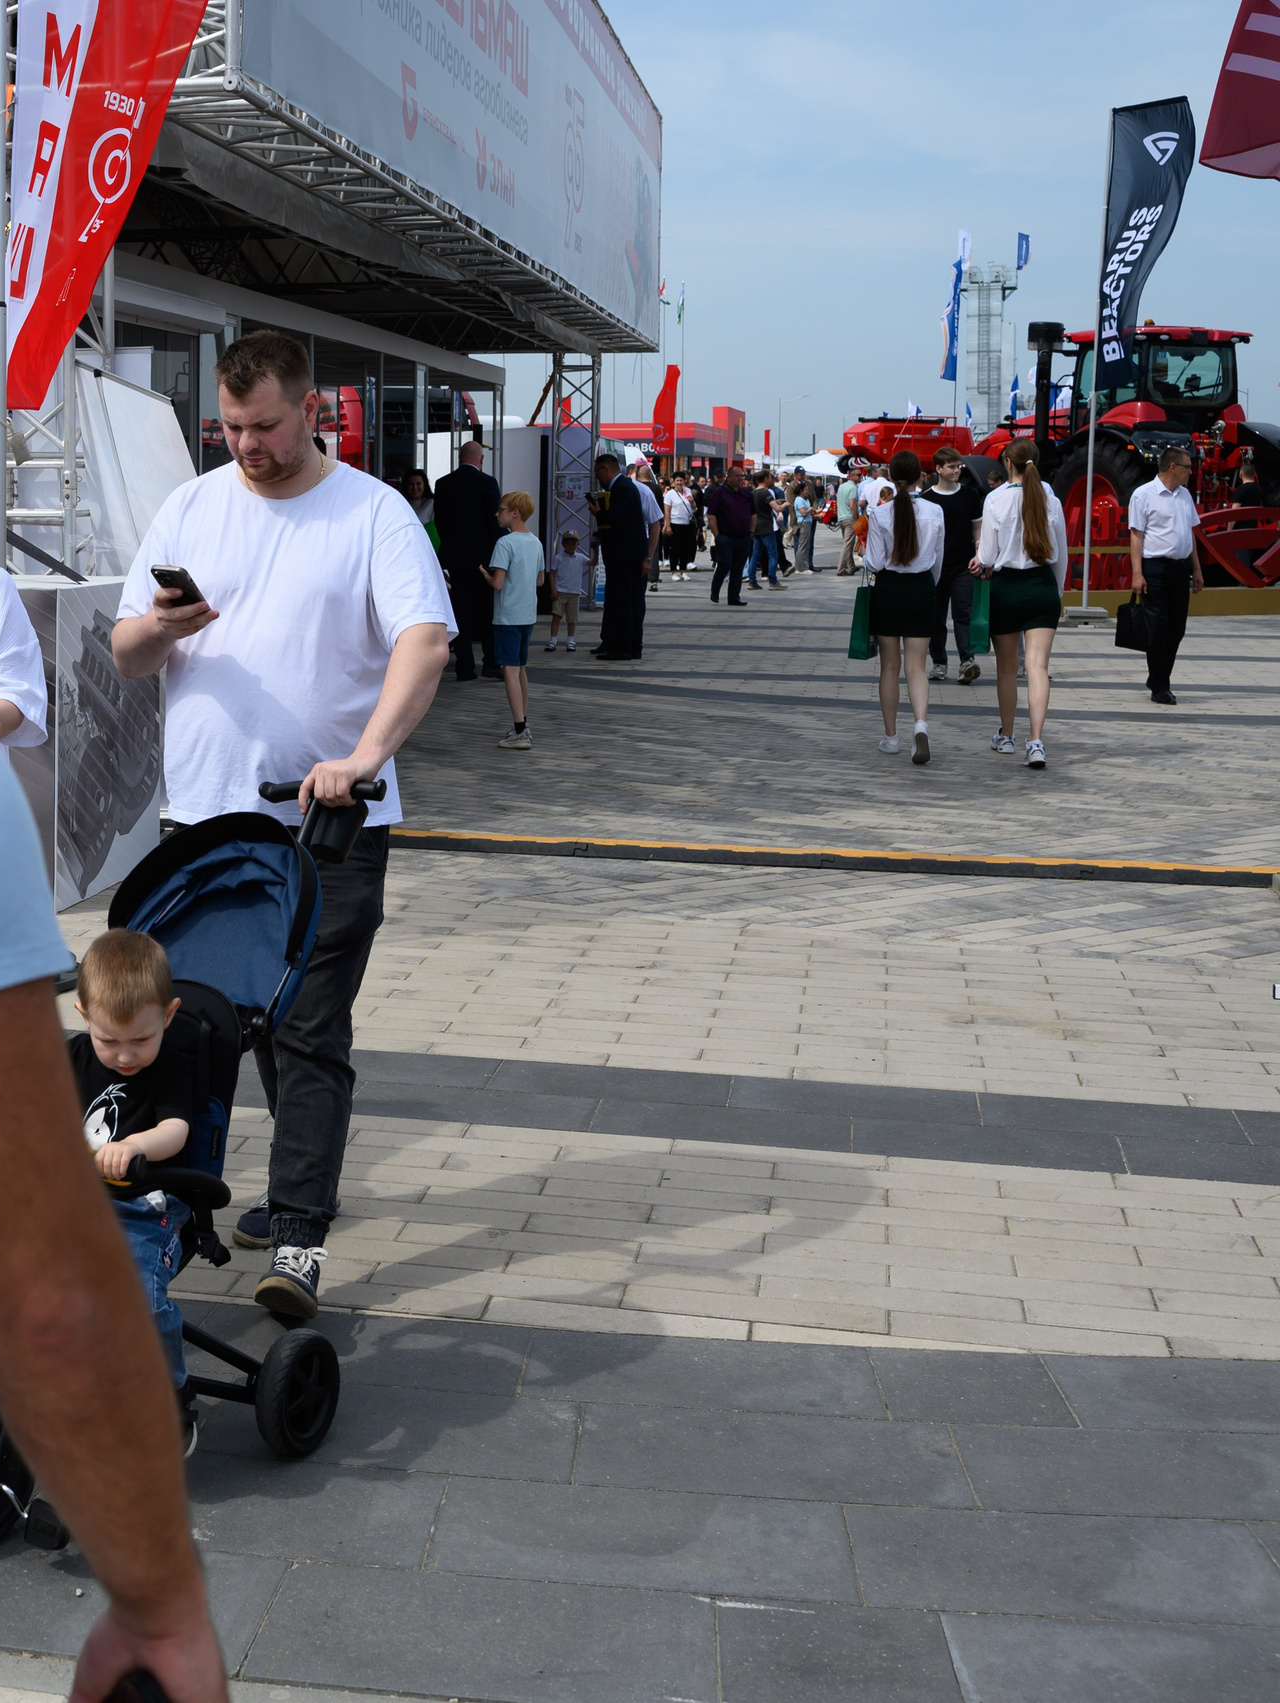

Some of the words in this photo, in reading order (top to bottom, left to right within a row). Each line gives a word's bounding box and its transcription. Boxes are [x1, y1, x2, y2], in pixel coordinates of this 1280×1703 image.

[103, 90, 135, 116] 1930
[425, 20, 472, 92] лидеров
[473, 68, 529, 146] агробизнеса
[1102, 206, 1149, 362] BELARUS
